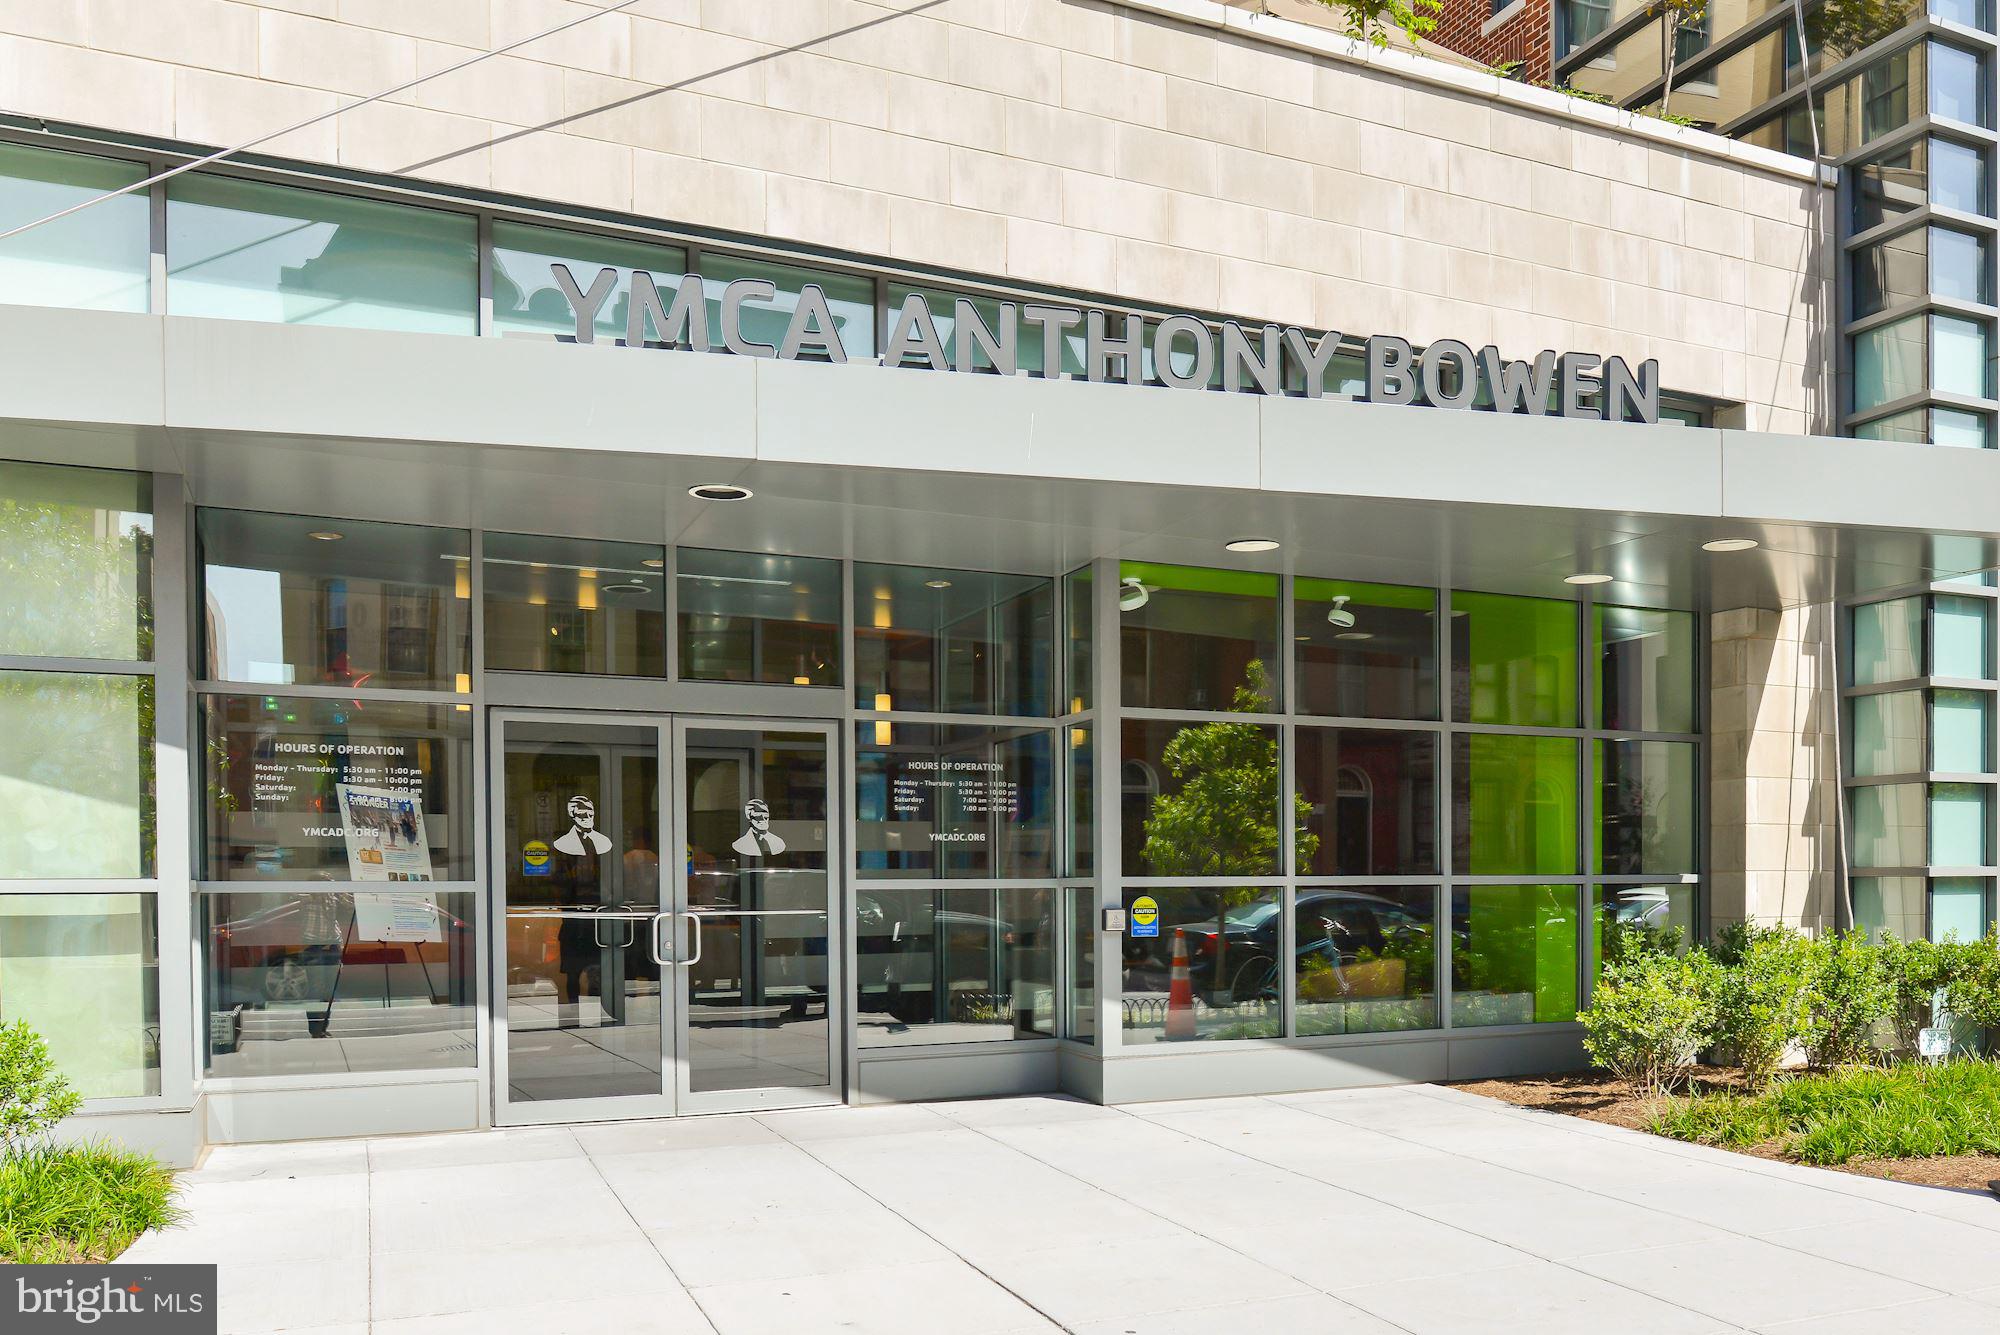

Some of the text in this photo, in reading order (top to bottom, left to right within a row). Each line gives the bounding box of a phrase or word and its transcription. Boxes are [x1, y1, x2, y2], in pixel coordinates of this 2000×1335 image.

[549, 262, 1660, 424] YMCA ANTHONY BOWEN
[274, 743, 404, 756] HOURS OF OPERATION
[255, 764, 289, 773] Monday
[296, 765, 339, 775] Thursday:
[343, 766, 363, 774] 5:30
[385, 767, 409, 775] 11:00
[410, 768, 422, 776] pm
[908, 761, 1004, 771] HOURS OF OPERATION
[255, 774, 285, 783] Friday:
[343, 775, 363, 783] 5:30
[385, 777, 409, 785] 10:00
[255, 783, 297, 793] Saturday:
[255, 793, 289, 802] Sunday:
[302, 826, 380, 838] YMCADC.ORG
[928, 833, 986, 842] YMCADC.ORG
